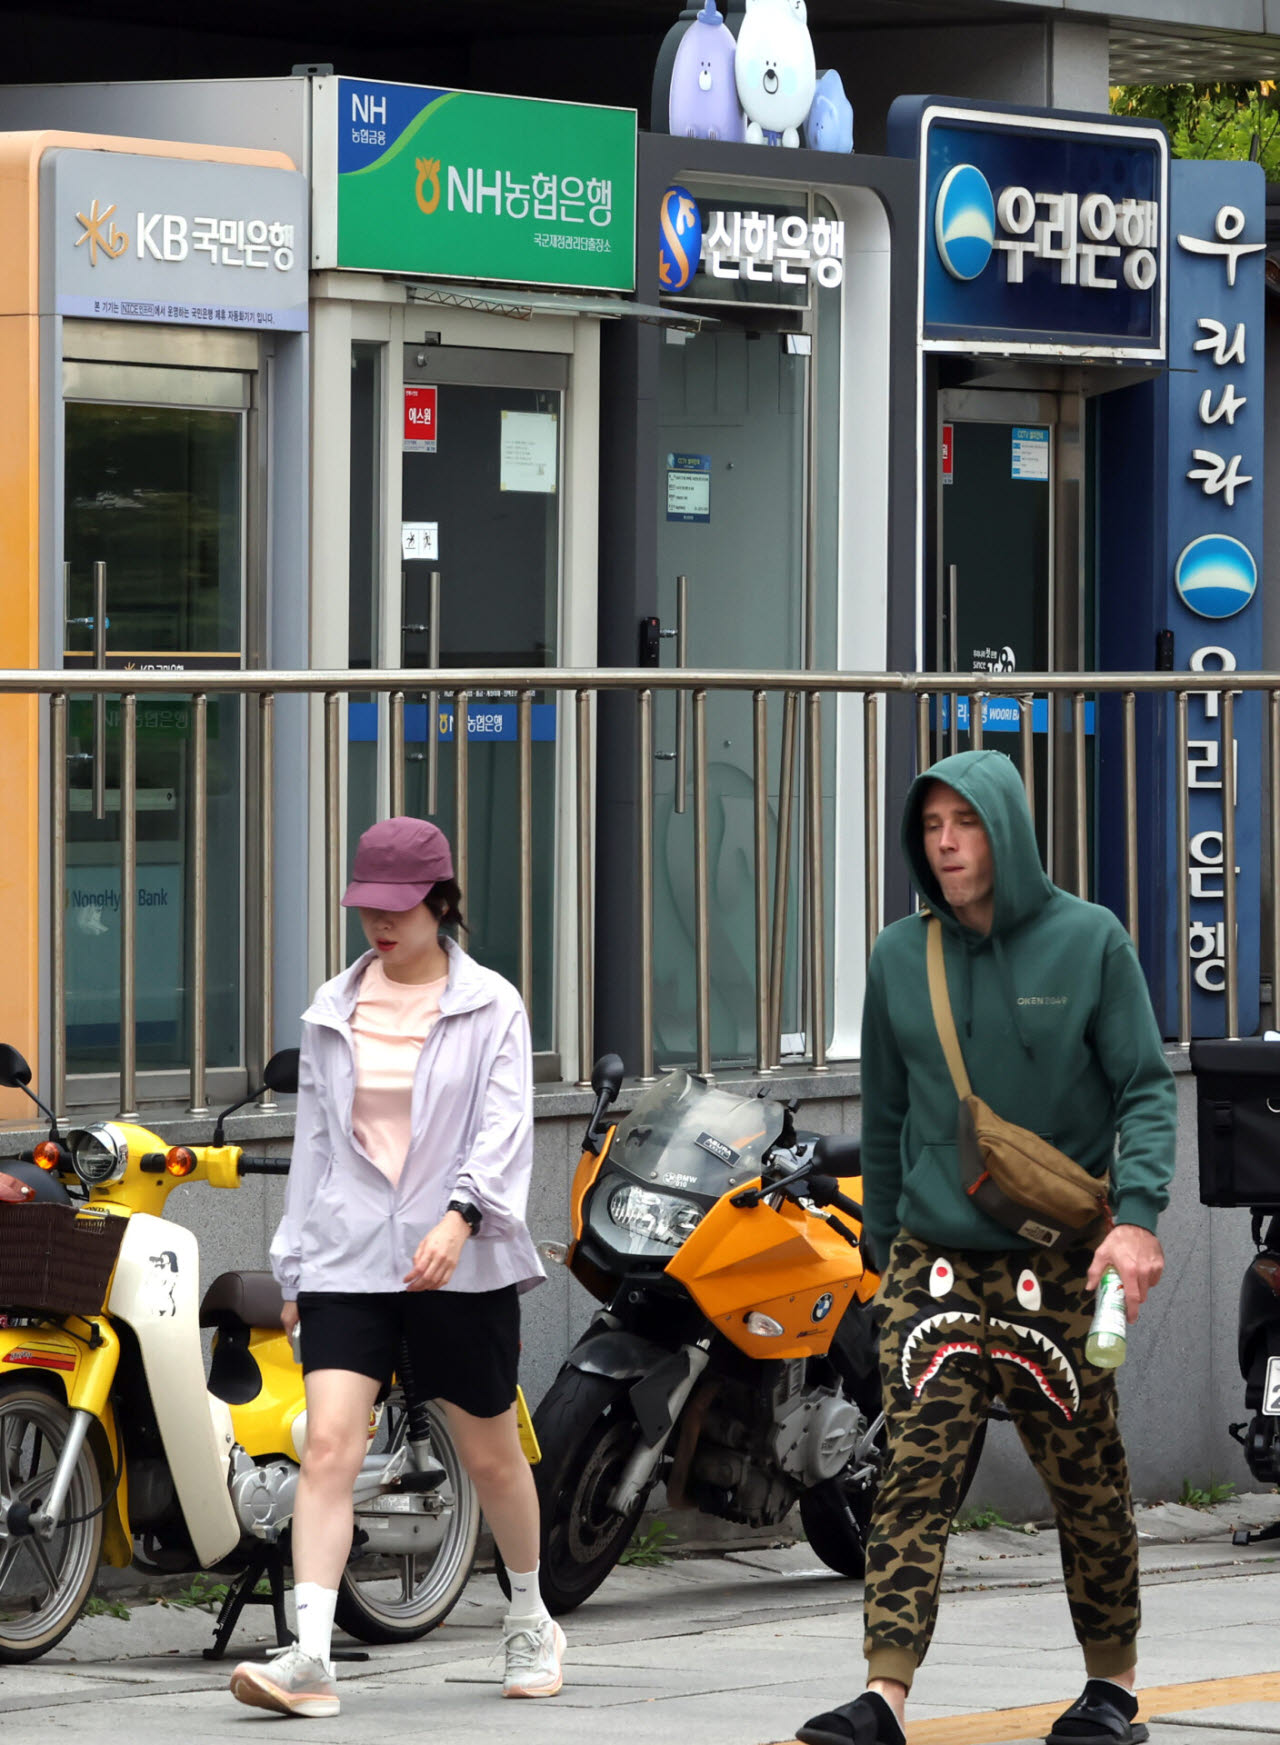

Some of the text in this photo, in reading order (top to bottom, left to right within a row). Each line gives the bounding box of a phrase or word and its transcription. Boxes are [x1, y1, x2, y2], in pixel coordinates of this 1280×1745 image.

[351, 93, 387, 125] NH
[351, 128, 387, 146] 농협금융
[992, 186, 1159, 290] 우리은행
[707, 210, 845, 289] 신한은행
[102, 302, 119, 314] 기기는
[167, 305, 190, 318] 운영하는
[191, 307, 213, 320] 국민은행
[214, 309, 226, 320] 제휴
[408, 408, 432, 425] 에스원
[989, 708, 1012, 720] WOORI
[138, 888, 168, 906] Bank
[677, 1173, 698, 1184] BMW
